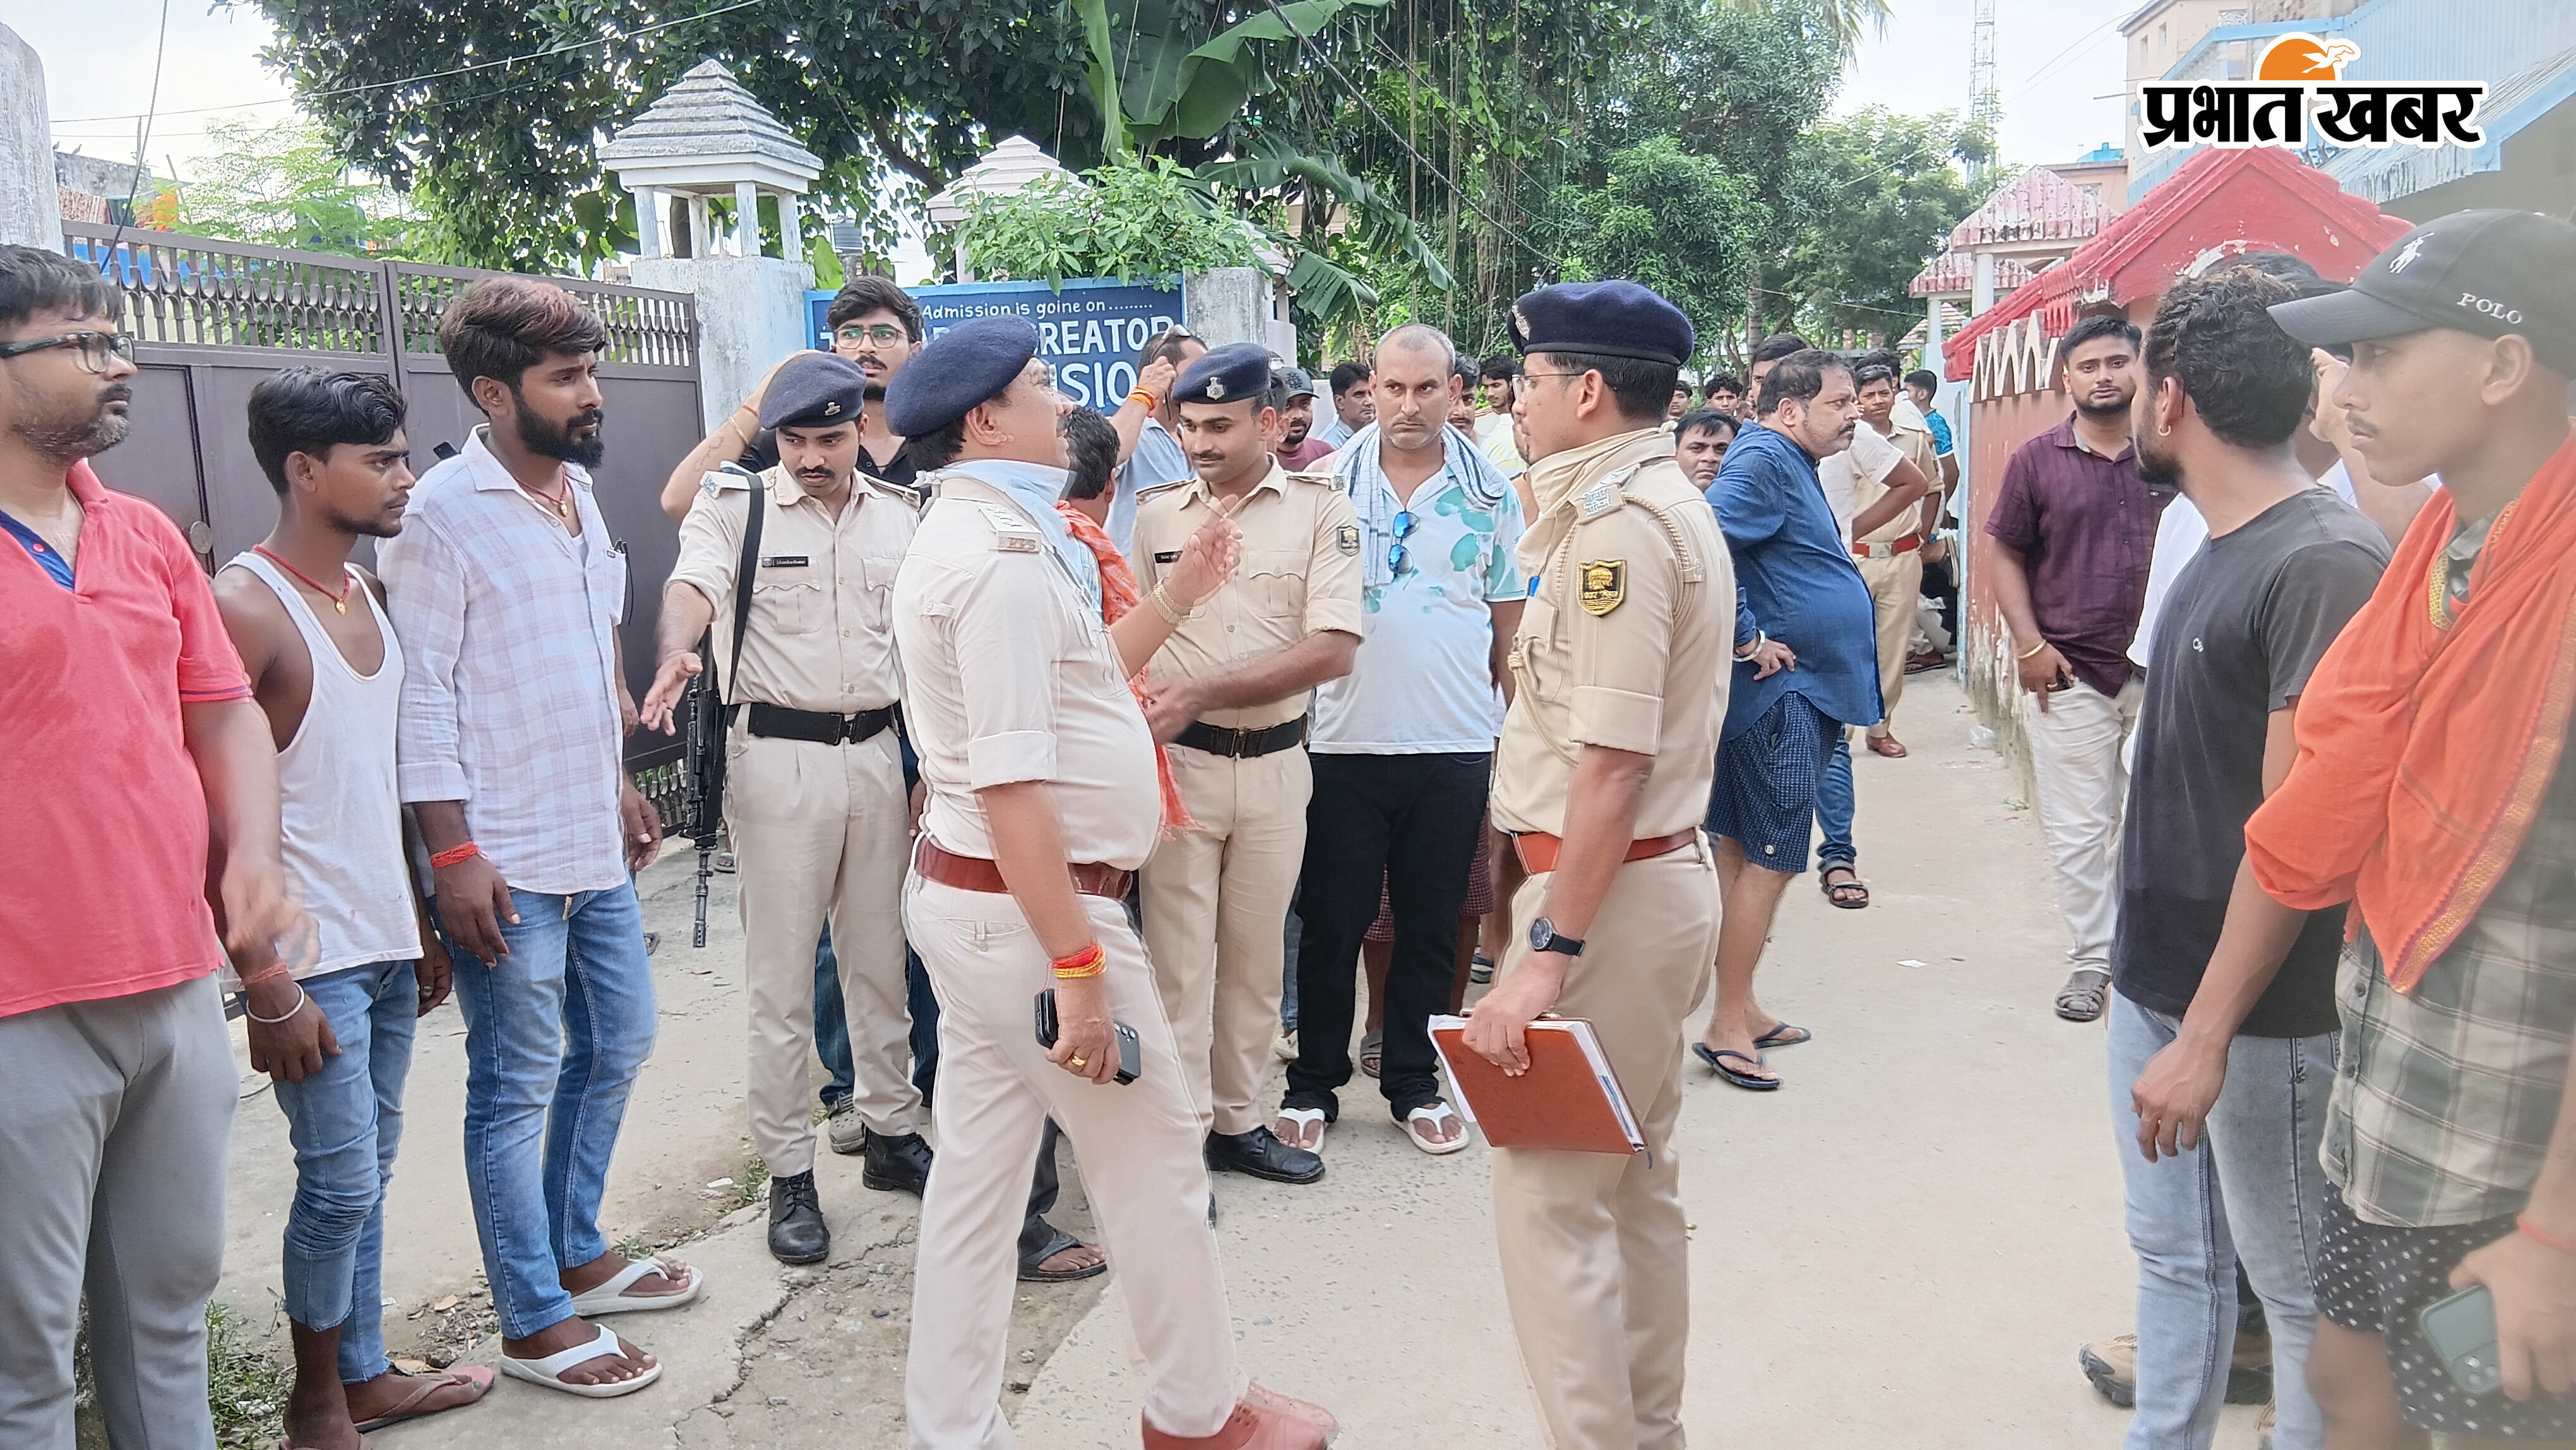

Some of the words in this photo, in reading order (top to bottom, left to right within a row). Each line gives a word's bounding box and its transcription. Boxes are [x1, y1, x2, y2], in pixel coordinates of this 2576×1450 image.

[922, 303, 1010, 320] Admission
[1015, 302, 1030, 315] is
[2457, 292, 2522, 324] POLO
[1030, 316, 1174, 356] REATO
